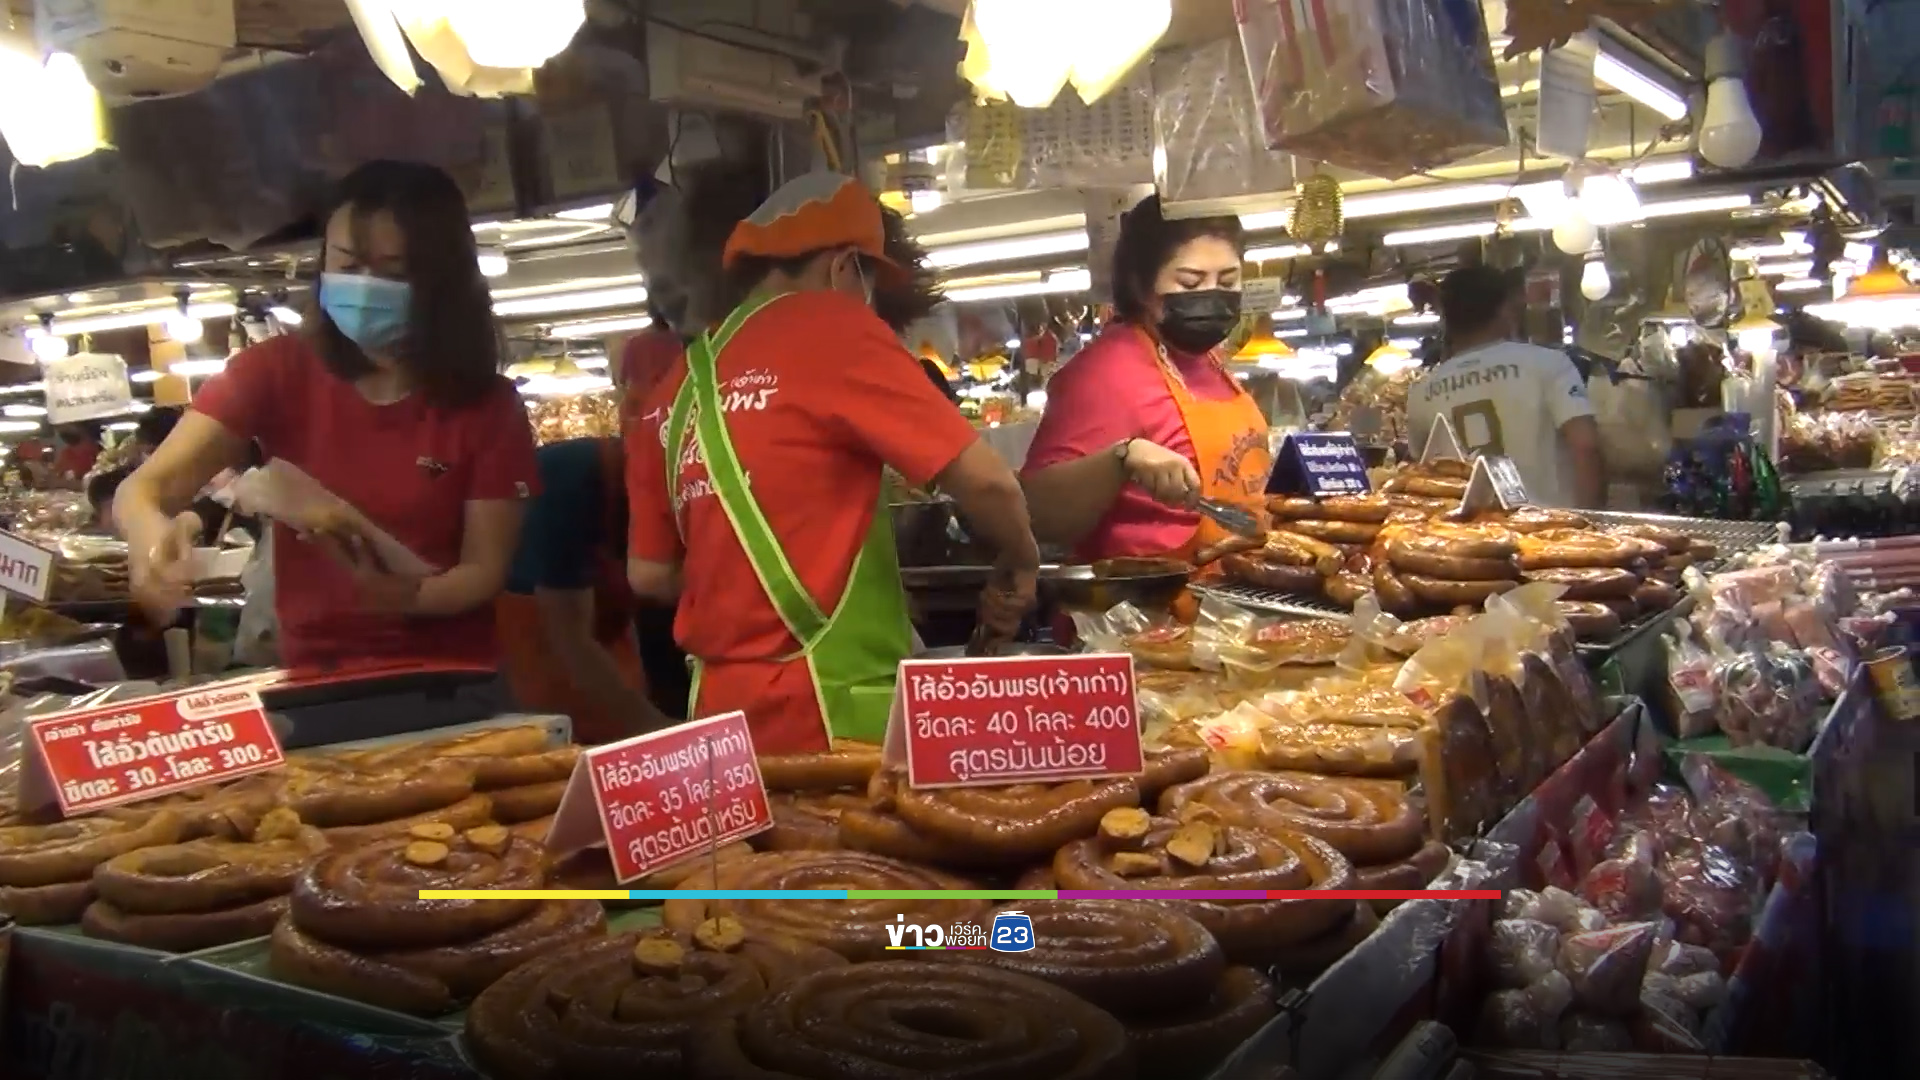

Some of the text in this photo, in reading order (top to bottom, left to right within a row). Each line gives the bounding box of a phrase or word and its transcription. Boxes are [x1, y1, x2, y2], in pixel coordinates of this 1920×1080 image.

[910, 667, 1128, 701] ไส้อั่วอัมพร(เจ้าเก่า)
[915, 704, 1131, 739] ขีดละ 40 โลละ 400
[949, 736, 1107, 781] สูตรมันน้อย
[609, 800, 655, 830] ขีดละ
[659, 786, 683, 814] 35
[724, 762, 756, 792] 350
